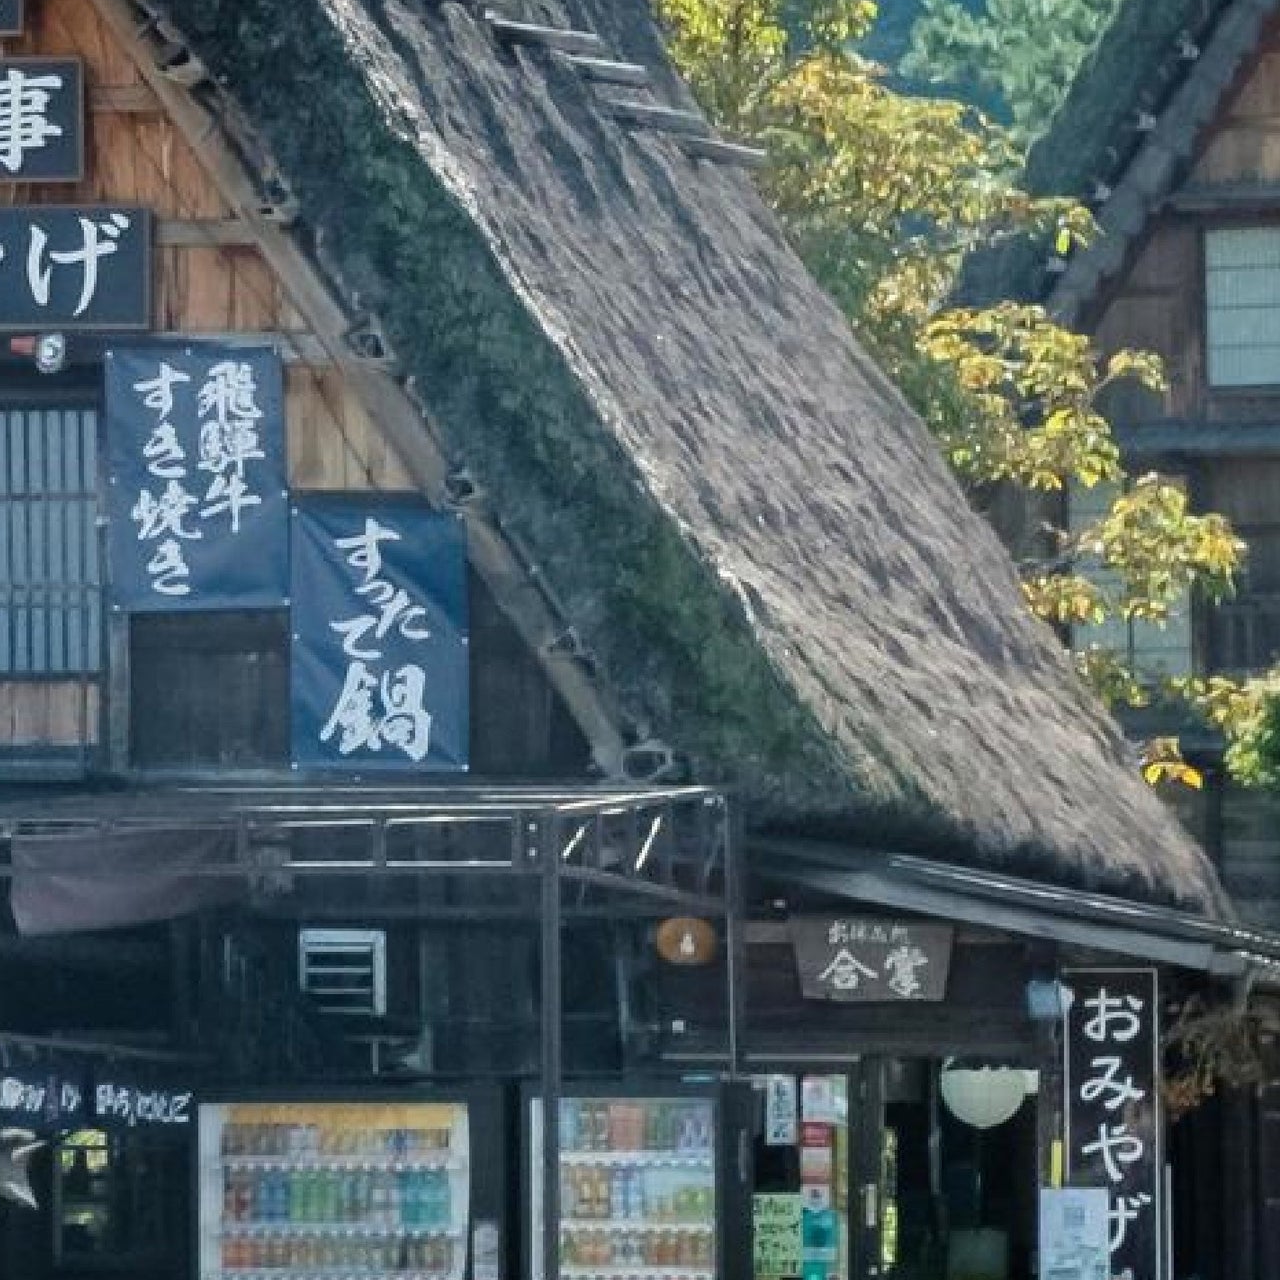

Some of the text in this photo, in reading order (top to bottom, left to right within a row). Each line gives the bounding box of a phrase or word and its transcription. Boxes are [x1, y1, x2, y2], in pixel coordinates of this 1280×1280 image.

[131, 362, 203, 595] すき焼き
[320, 518, 432, 762] すったて鍋
[1080, 988, 1152, 1253] おみやげ
